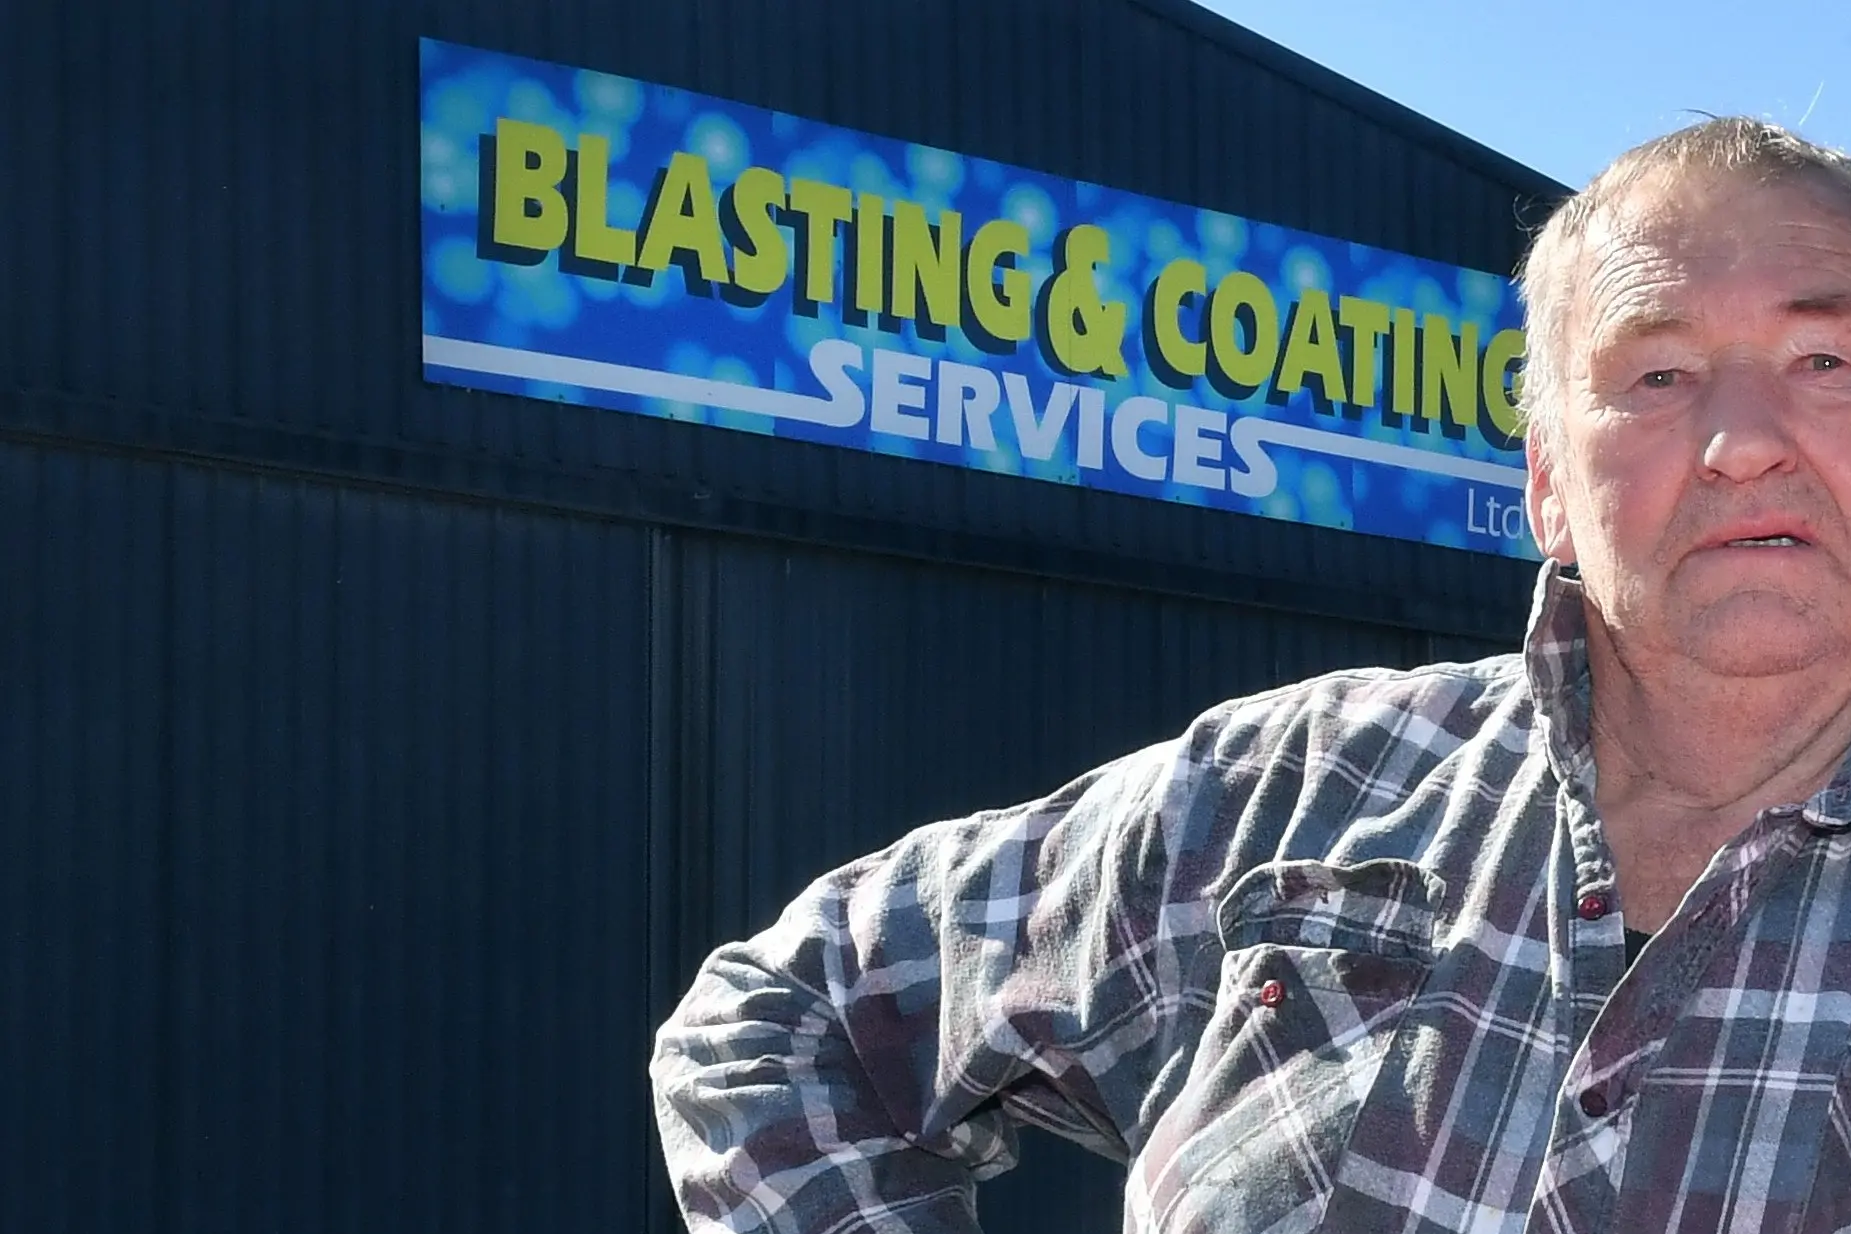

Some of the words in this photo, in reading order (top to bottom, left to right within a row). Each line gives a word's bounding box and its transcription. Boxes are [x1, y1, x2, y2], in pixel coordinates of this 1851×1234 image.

[493, 116, 1032, 342] BLASTING
[1047, 224, 1128, 378] &
[808, 338, 1278, 498] SERVICES
[1467, 488, 1525, 539] Ltd
